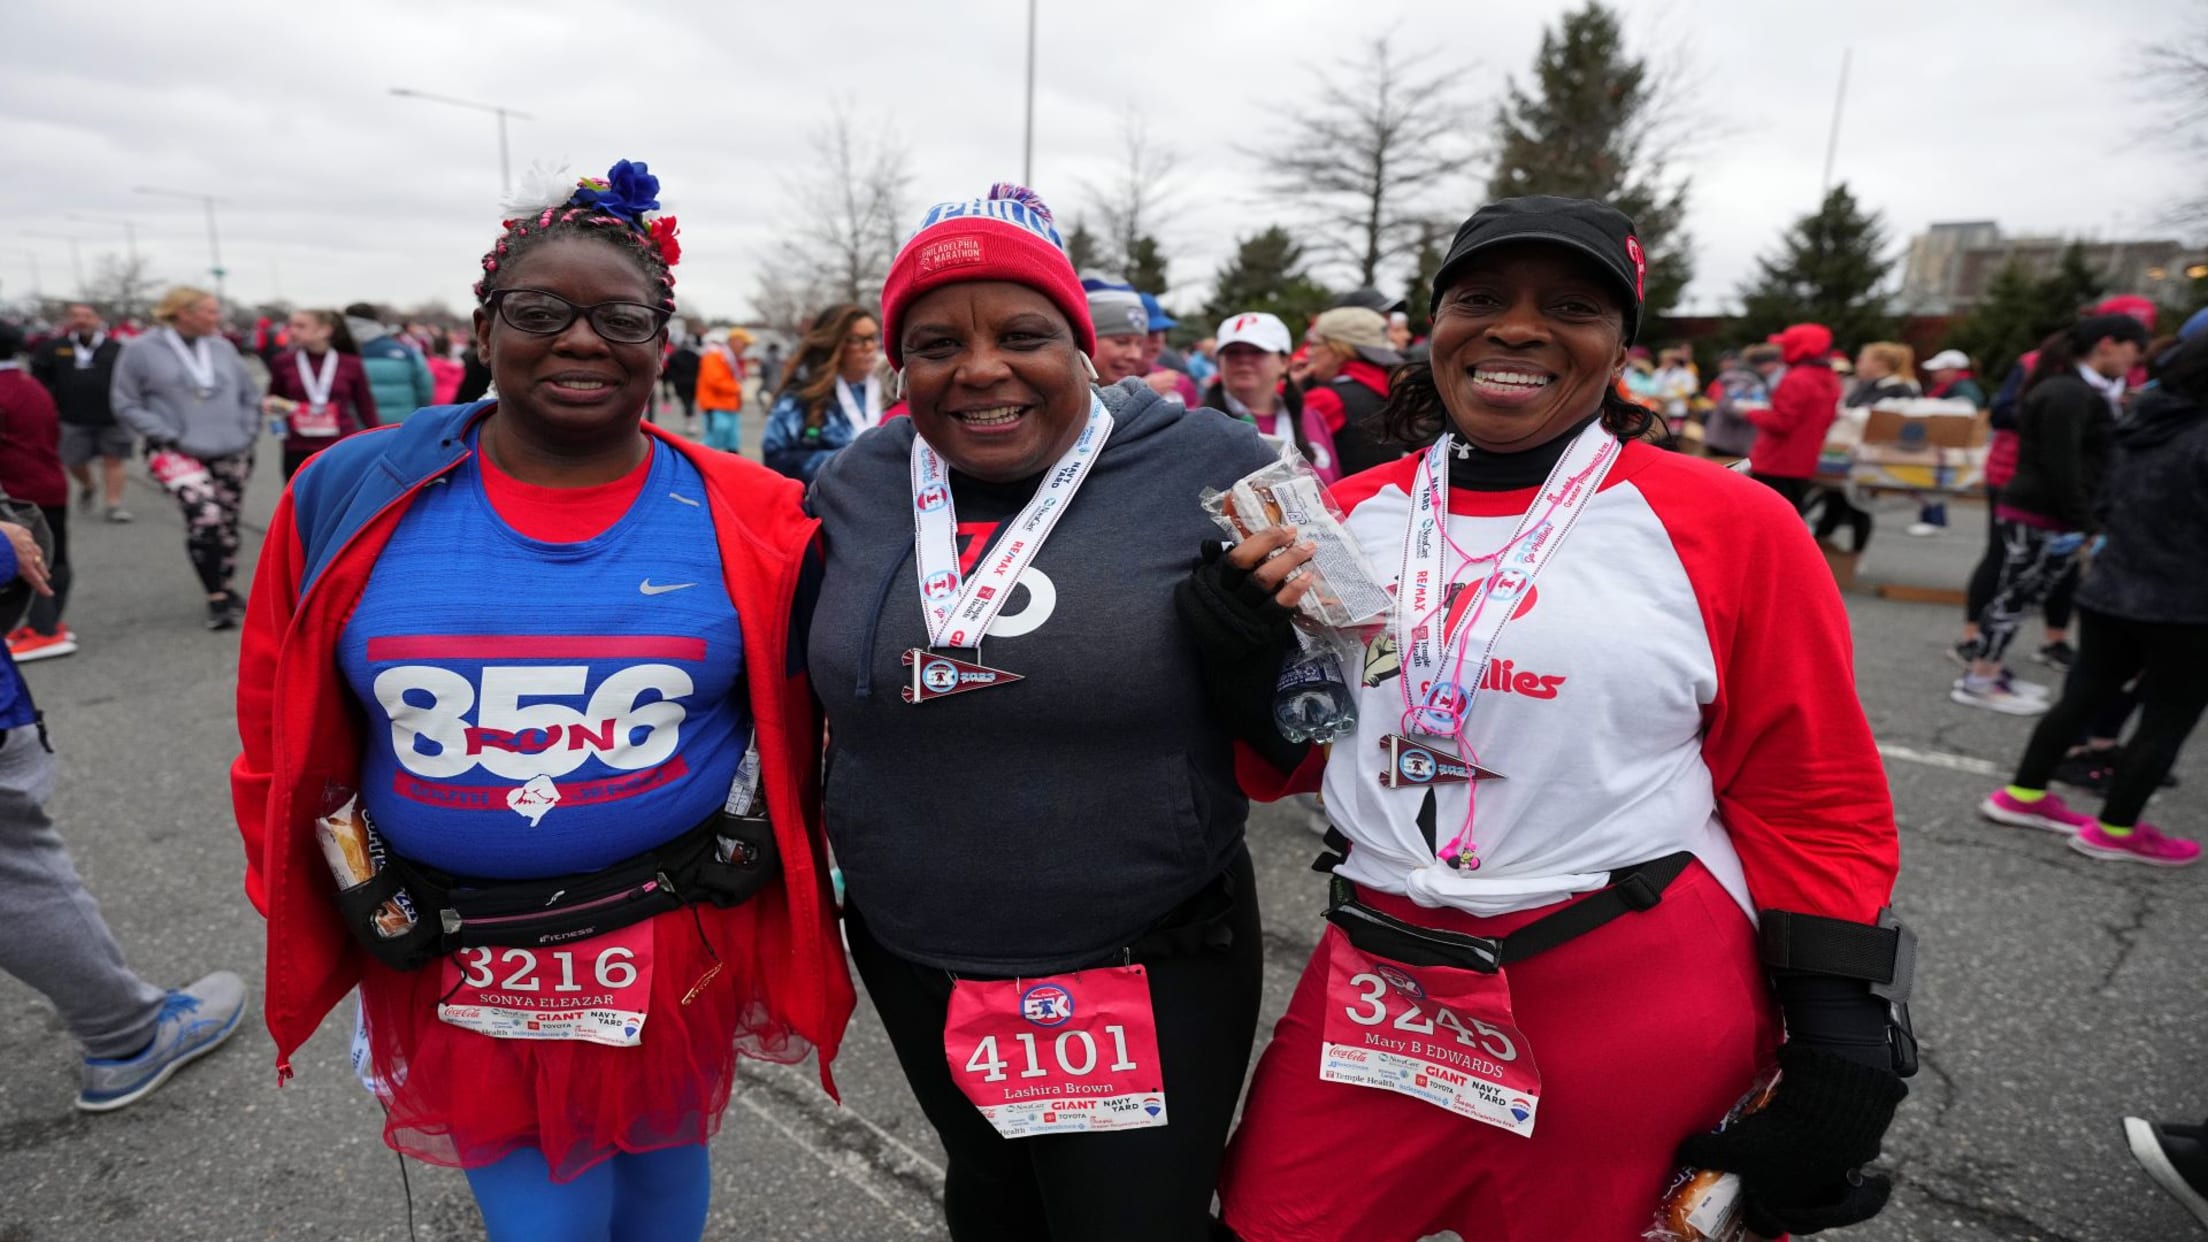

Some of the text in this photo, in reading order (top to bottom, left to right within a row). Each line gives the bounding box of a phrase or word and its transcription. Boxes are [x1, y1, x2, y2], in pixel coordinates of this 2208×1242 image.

[921, 240, 979, 258] PHILADELPHIA
[934, 249, 980, 263] MARATHON
[1051, 467, 1068, 489] YARD
[1063, 461, 1081, 484] NAVY
[1421, 486, 1430, 511] YARD
[1421, 528, 1432, 559] NovaCare
[994, 540, 1025, 576] RE/MAX
[1414, 570, 1428, 612] RE/MAX
[1421, 640, 1431, 668] Temple
[373, 663, 694, 780] 856
[460, 946, 638, 992] 3216
[479, 993, 614, 1008] SONYA ELEAZAR
[1024, 995, 1071, 1019] 5K
[535, 1011, 584, 1021] GIANT
[590, 1011, 617, 1019] NAVY
[598, 1018, 623, 1027] YARD
[965, 1025, 1137, 1083] 4101
[1365, 1033, 1504, 1078] Mary B EDWARDS
[1004, 1083, 1114, 1099] Lashira Brown
[1335, 1072, 1365, 1082] Temple
[1366, 1076, 1395, 1088] Health
[1425, 1065, 1468, 1087] GIANT
[1471, 1081, 1501, 1095] NAVY
[1429, 1080, 1454, 1094] TOYOTA
[1051, 1100, 1097, 1111] GIANT
[1103, 1097, 1131, 1107] NAVY
[1112, 1103, 1139, 1112] YARD
[1479, 1091, 1506, 1106] YARD
